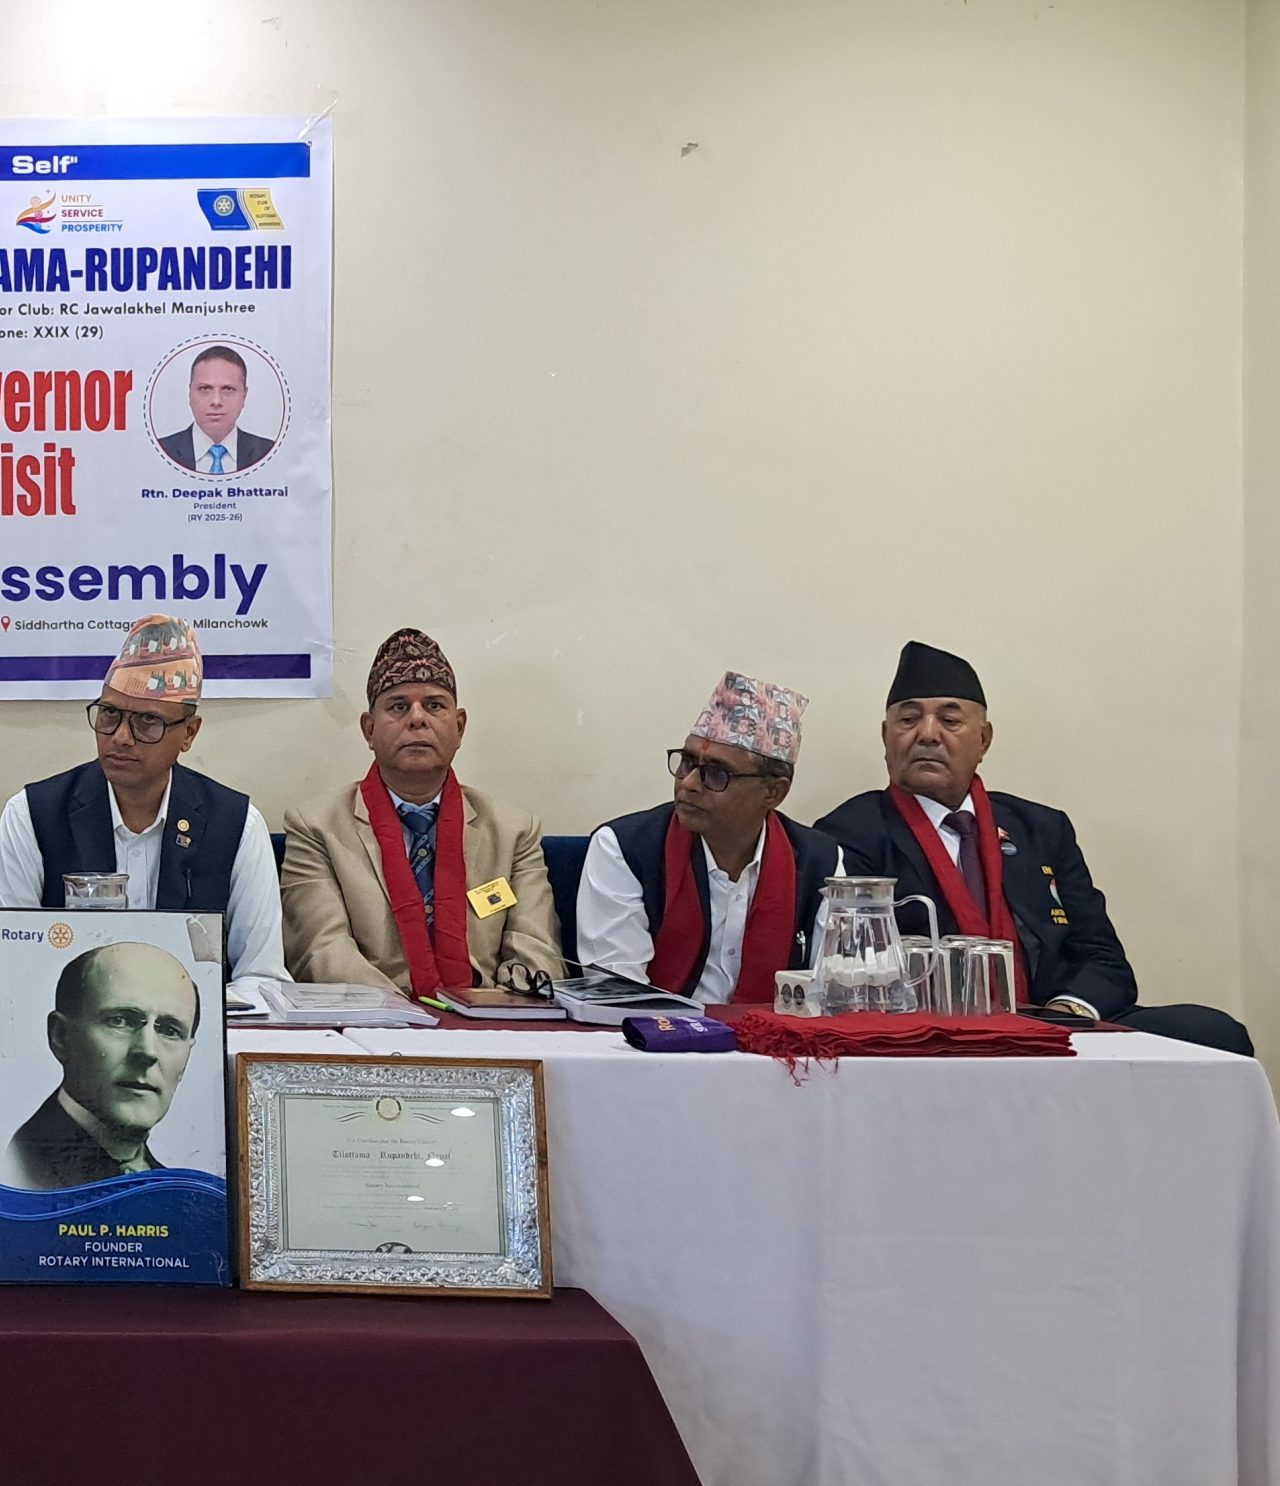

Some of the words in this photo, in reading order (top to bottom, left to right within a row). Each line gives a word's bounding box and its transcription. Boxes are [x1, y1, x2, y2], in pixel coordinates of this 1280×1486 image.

[11, 155, 78, 175] Self"
[61, 194, 92, 203] UNITY
[61, 207, 104, 218] SERVICE
[61, 222, 124, 233] PROSPERITY
[17, 302, 55, 316] Club:
[59, 302, 79, 316] RC
[83, 300, 166, 316] Jawalakhel
[171, 299, 256, 318] Manjushree
[33, 324, 70, 339] XXIX
[75, 324, 104, 341] (29)
[141, 488, 169, 499] Rtn.
[172, 487, 223, 502] Deepak
[226, 486, 289, 498] Bhattarai
[193, 501, 237, 511] President
[187, 513, 203, 523] (RY
[204, 512, 244, 523] 2025-26)
[14, 618, 85, 632] Siddhartha
[193, 616, 269, 630] Milanchowk
[1, 928, 45, 944] Rotary
[58, 1223, 97, 1237] PAUL
[99, 1224, 113, 1237] P.
[116, 1224, 170, 1238] HARRIS
[84, 1241, 143, 1253] FOUNDER
[38, 1255, 90, 1267] ROTARY
[91, 1256, 190, 1268] INTERNATIONAL
